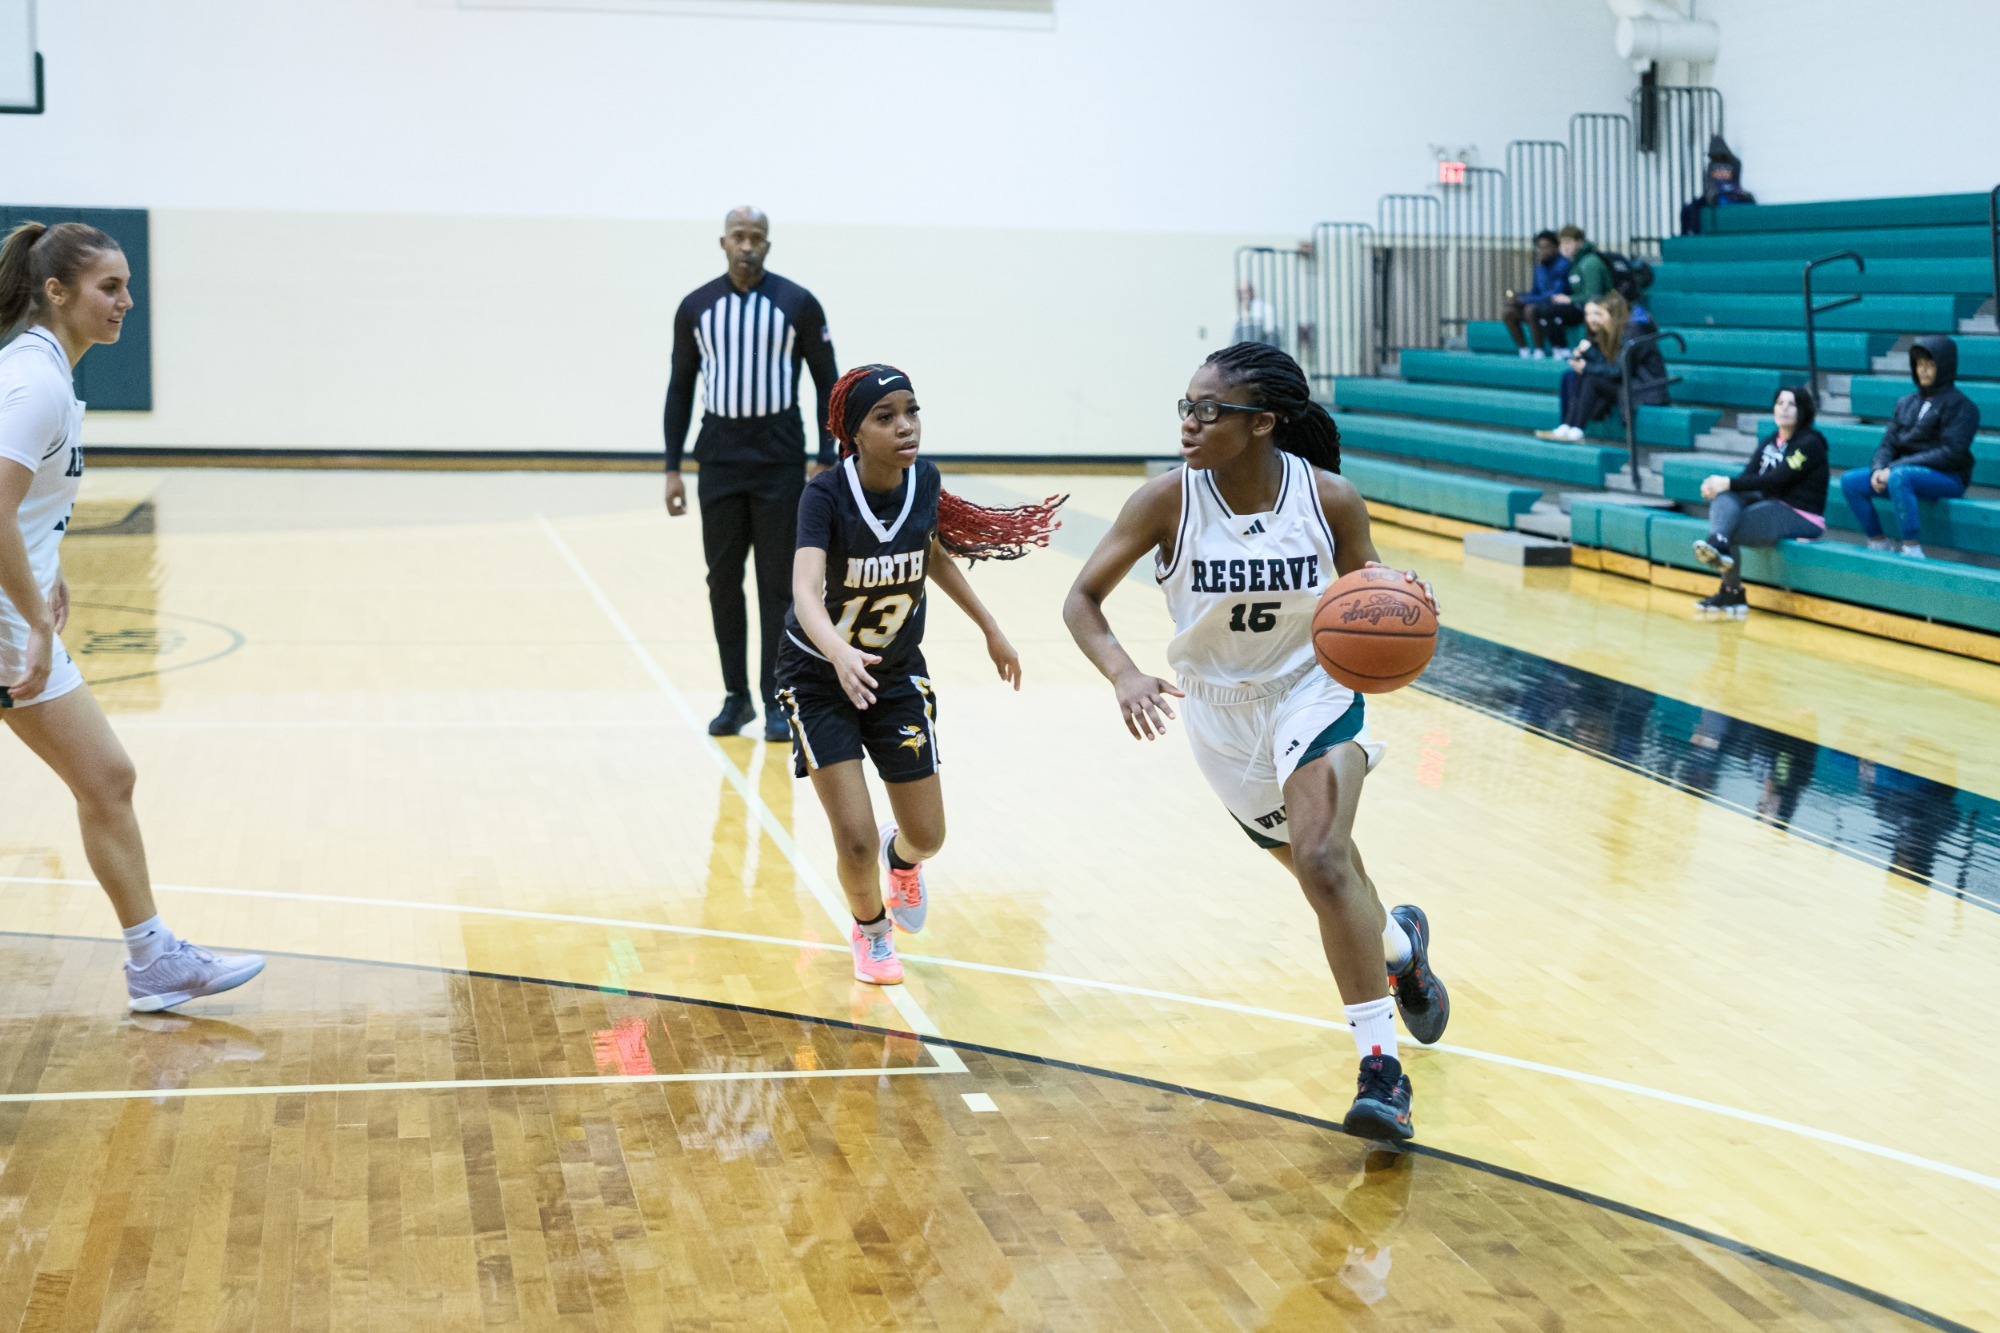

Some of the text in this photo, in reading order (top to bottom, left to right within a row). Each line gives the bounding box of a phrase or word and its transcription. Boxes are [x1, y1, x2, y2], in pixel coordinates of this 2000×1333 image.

[843, 549, 925, 589] NORTH
[1191, 554, 1318, 593] RESERVE
[834, 593, 914, 649] 13
[1340, 599, 1421, 626] Rawlings
